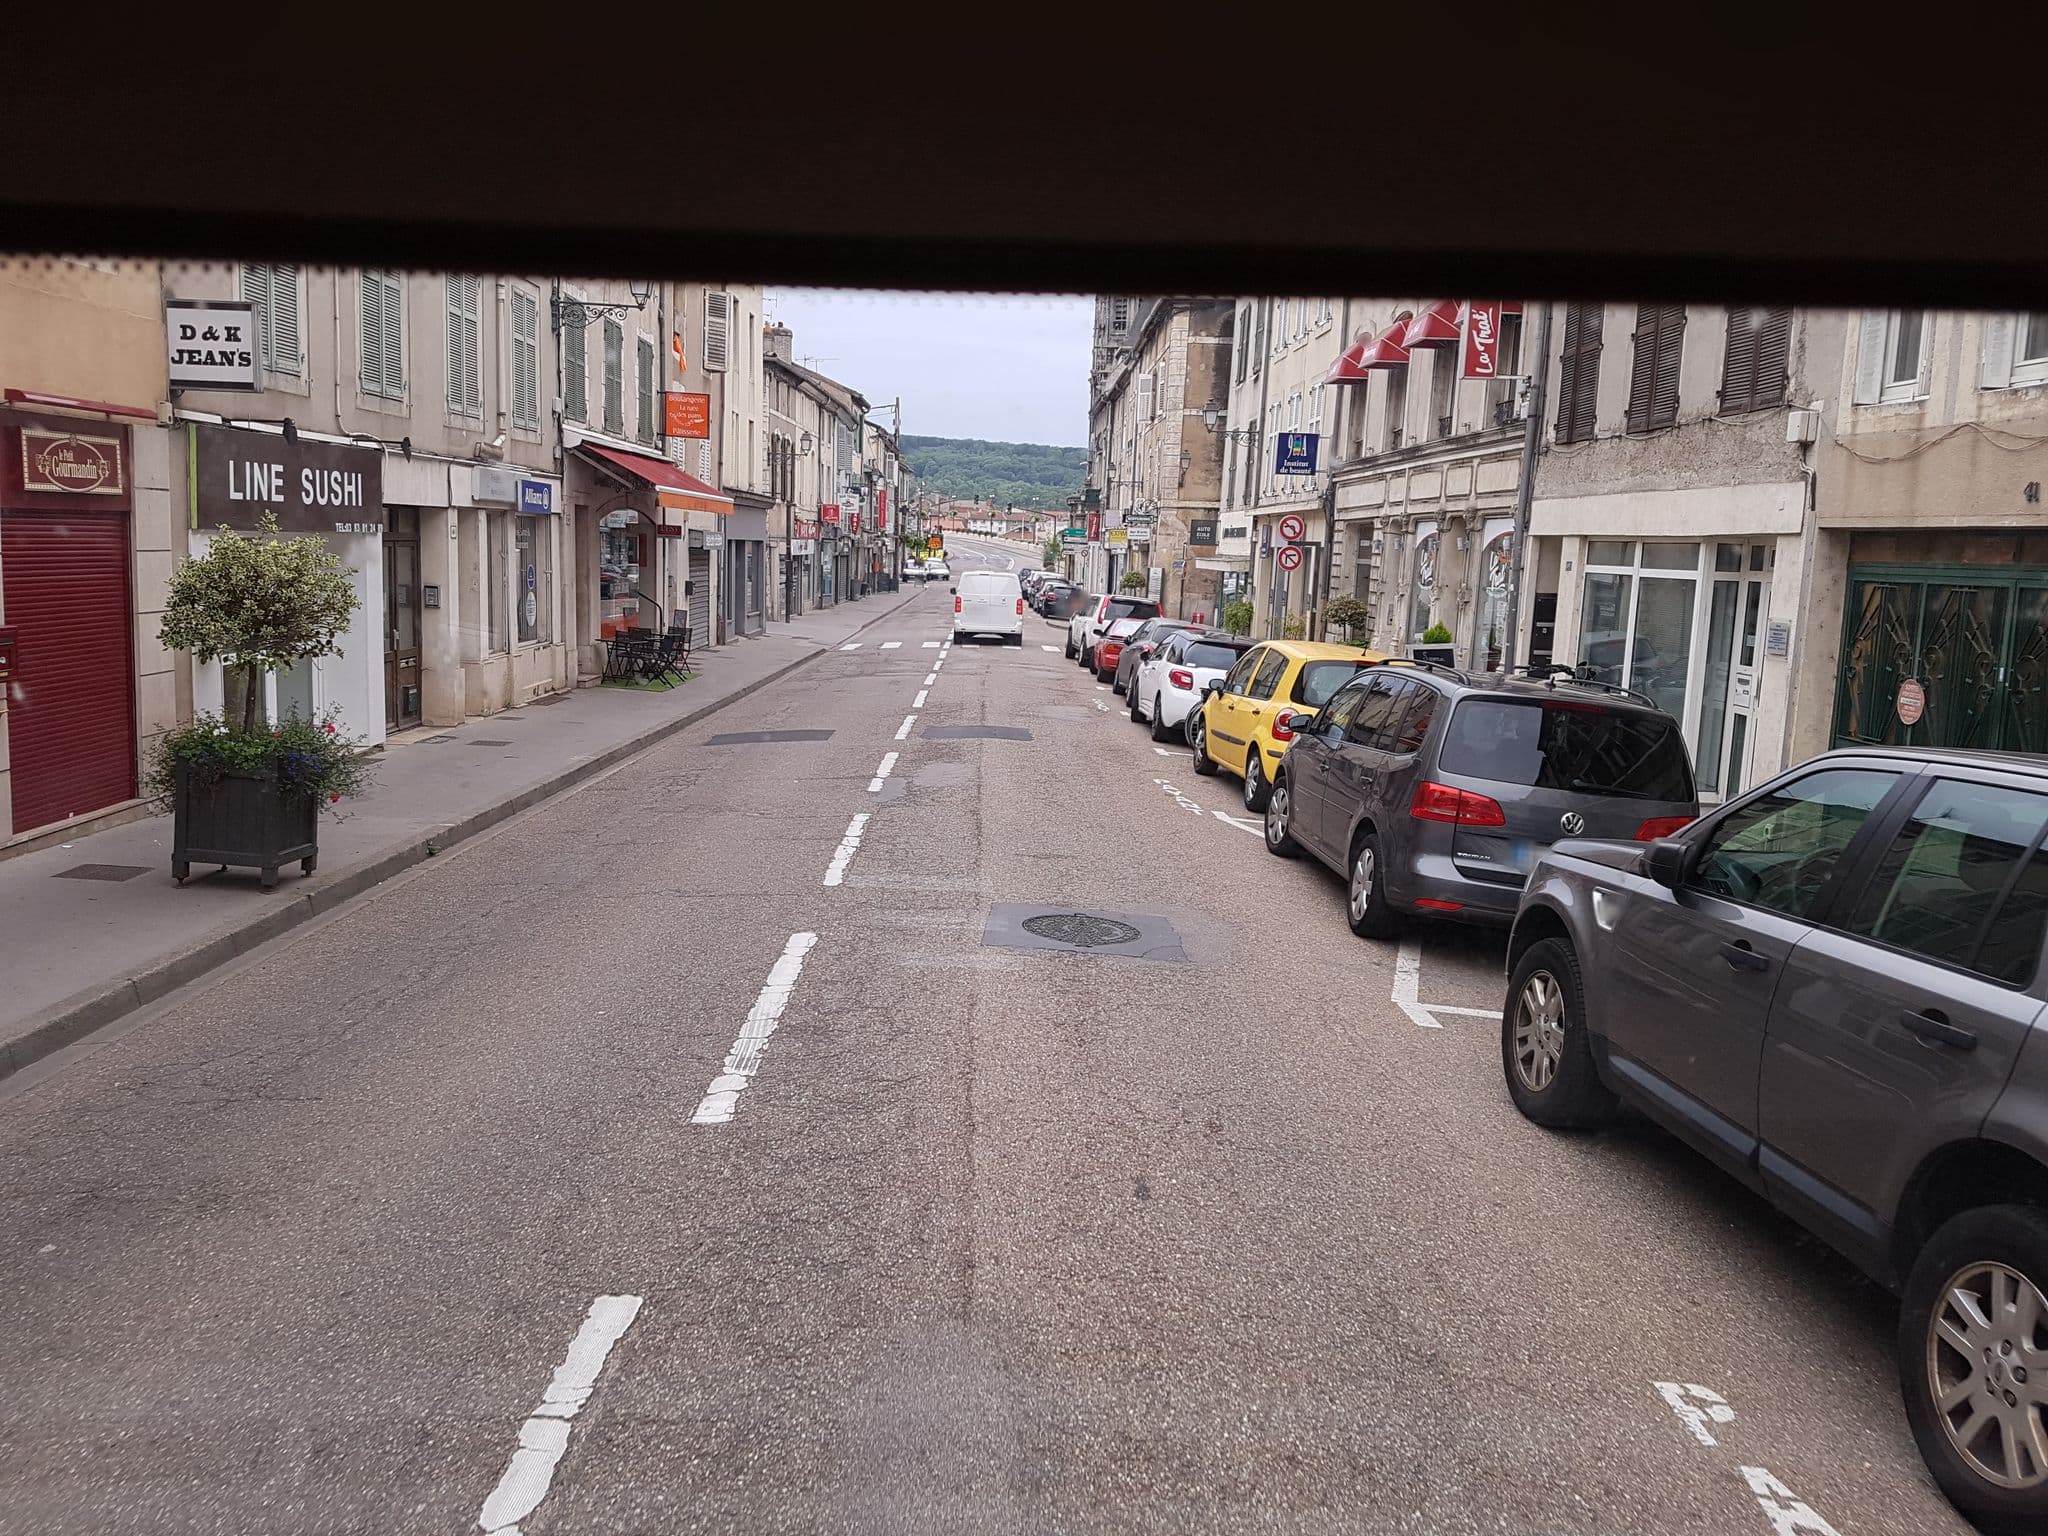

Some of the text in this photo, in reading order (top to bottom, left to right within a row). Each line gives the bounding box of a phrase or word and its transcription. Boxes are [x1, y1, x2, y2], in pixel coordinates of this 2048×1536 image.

[179, 324, 241, 342] D & K
[170, 347, 251, 367] JEAN'S
[1475, 352, 1493, 373] La
[52, 455, 98, 479] Gourmandin
[1284, 459, 1309, 467] Institut
[1289, 466, 1312, 474] beauté
[229, 460, 363, 507] LINE SUSHI
